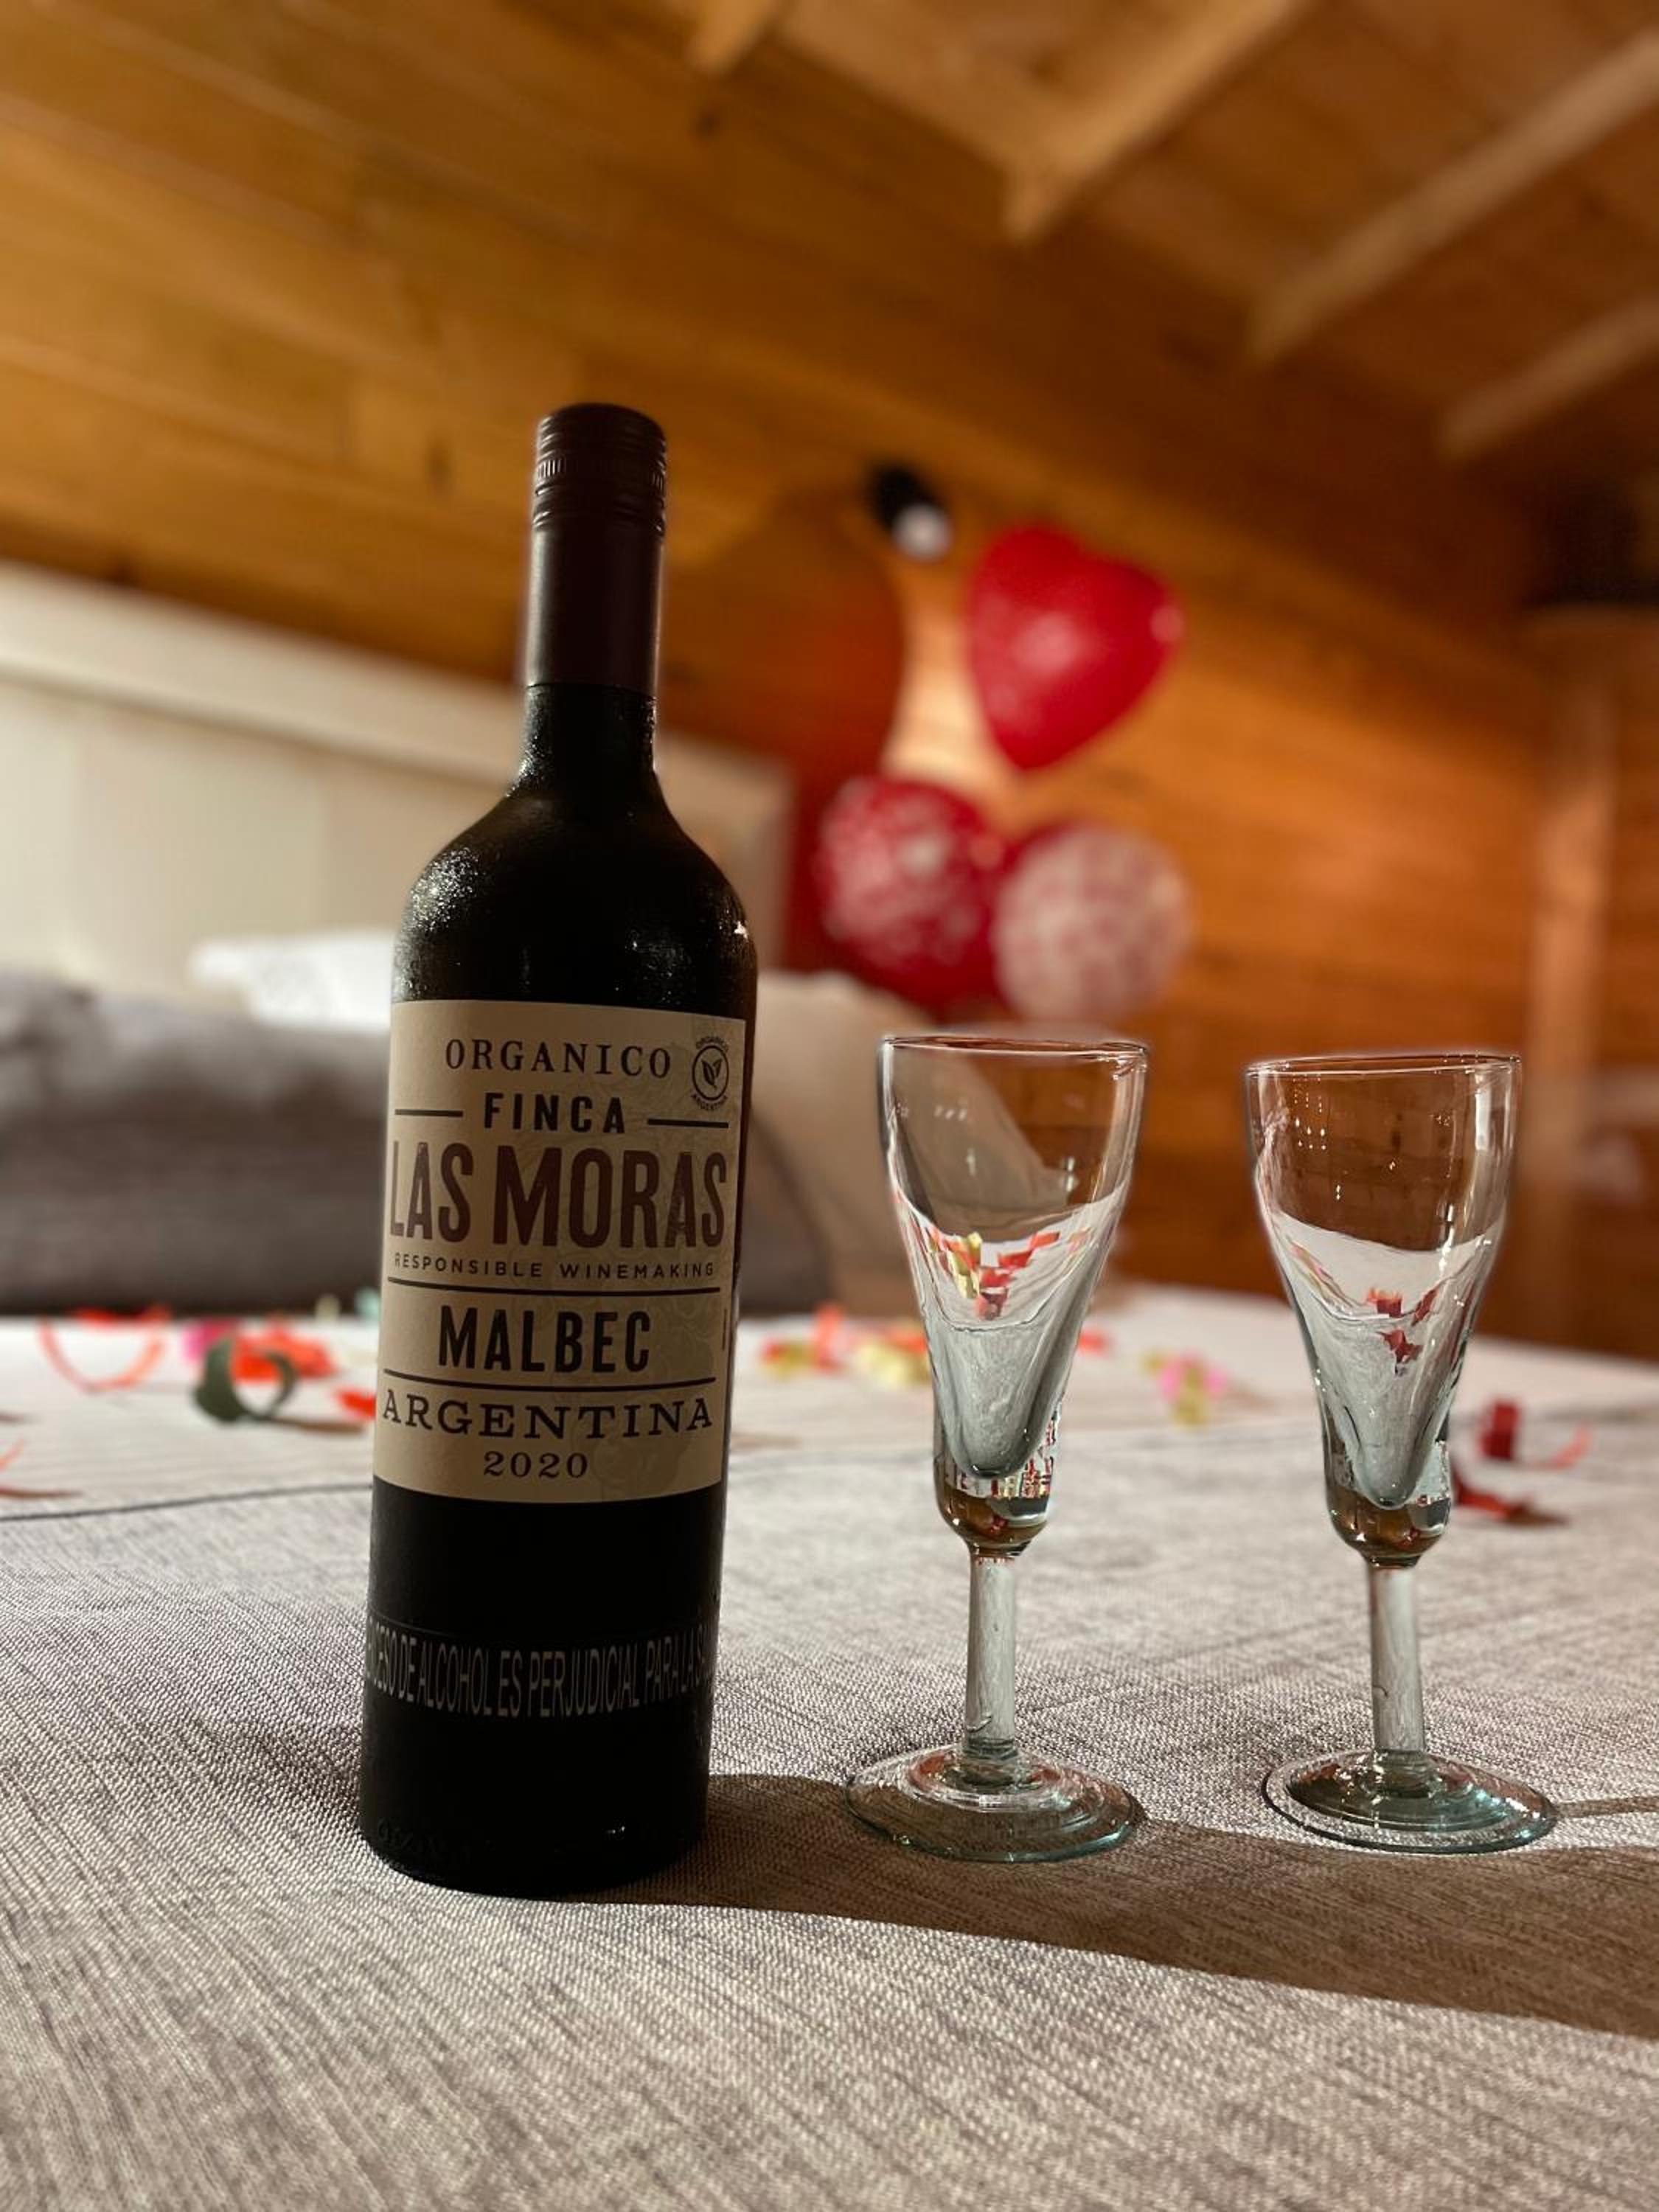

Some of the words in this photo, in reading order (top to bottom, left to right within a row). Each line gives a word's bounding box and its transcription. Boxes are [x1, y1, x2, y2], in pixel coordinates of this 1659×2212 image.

[445, 1038, 671, 1079] ORGANICO
[483, 1091, 626, 1134] FINCA
[389, 1140, 474, 1243] LAS
[493, 1144, 727, 1249] MORAS
[394, 1252, 543, 1279] RESPONSIBLE
[560, 1262, 714, 1280] WINEMAKING
[438, 1304, 651, 1374] MALBEC
[382, 1388, 714, 1441] ARGENTINA
[483, 1450, 589, 1479] 2020
[417, 1639, 493, 1718] ALCOHOL
[496, 1649, 522, 1718] ES
[526, 1643, 641, 1719] PERJUDICIAL
